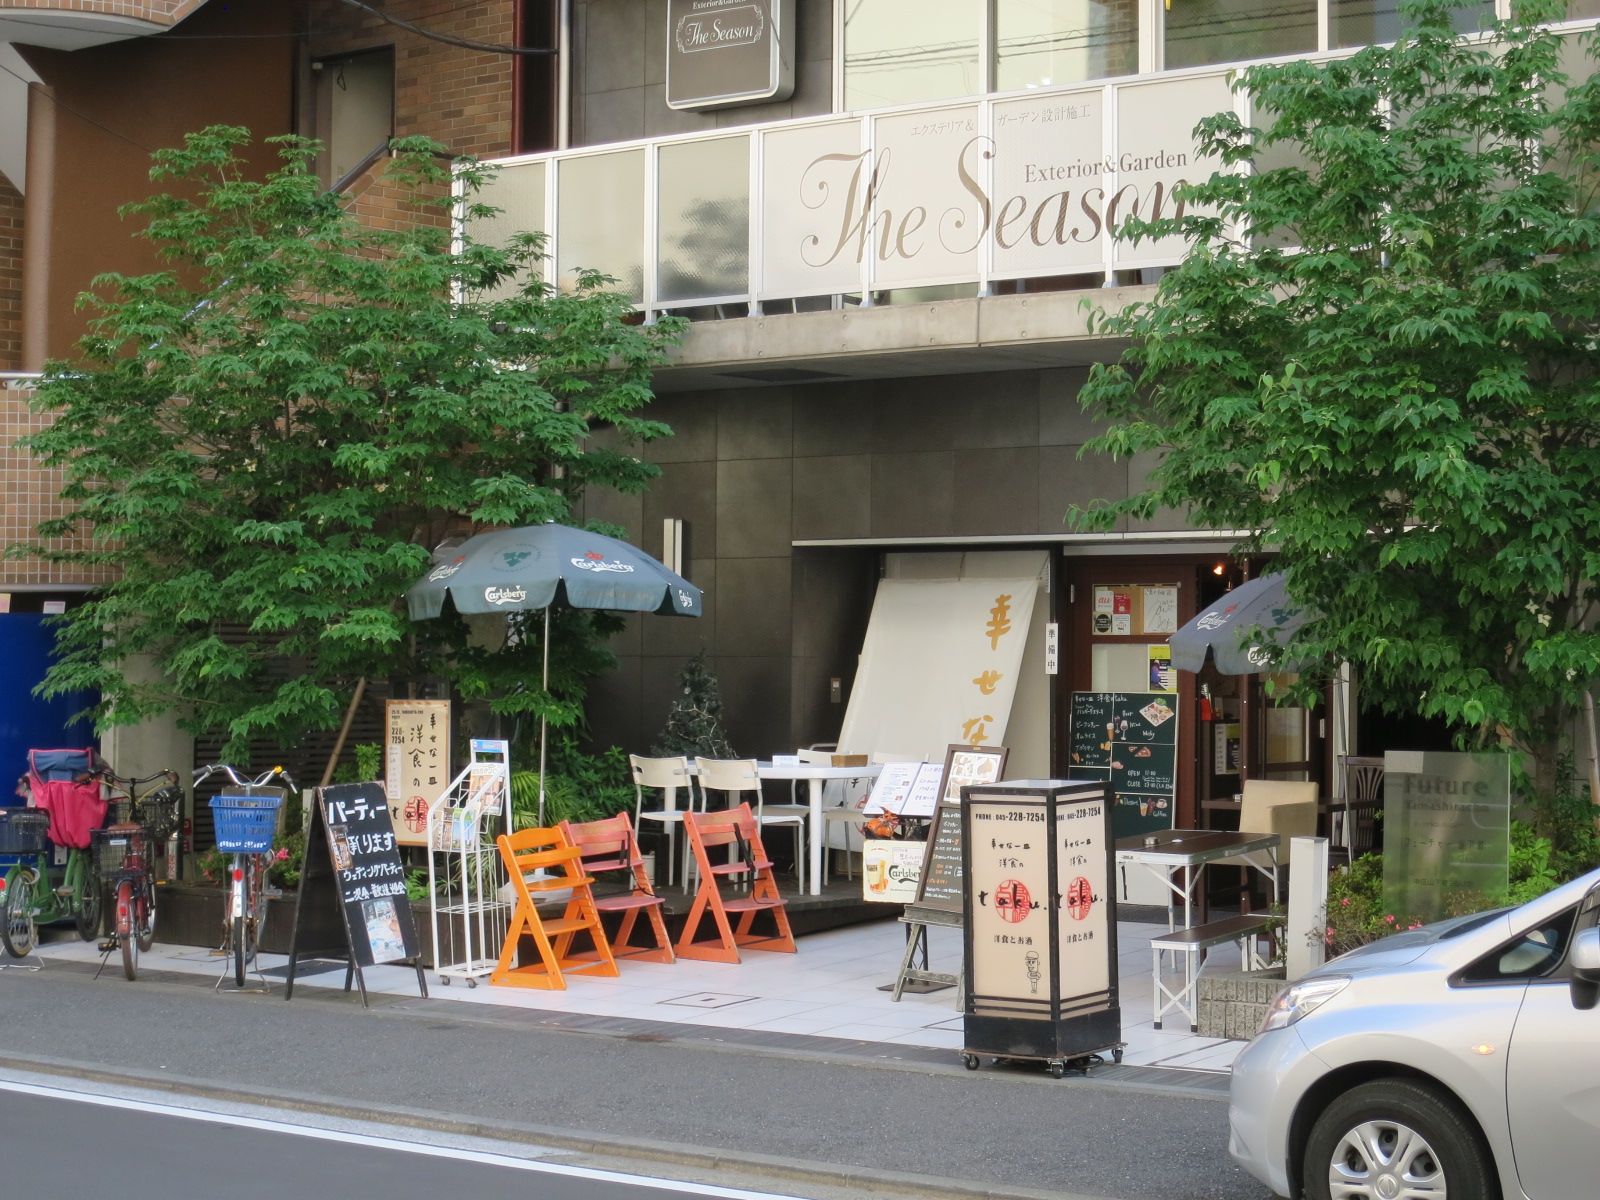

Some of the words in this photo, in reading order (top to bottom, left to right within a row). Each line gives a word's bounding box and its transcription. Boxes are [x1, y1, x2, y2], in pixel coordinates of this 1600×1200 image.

[685, 21, 709, 46] The
[709, 18, 754, 42] Season
[1025, 149, 1188, 183] Exterior&Garden
[800, 146, 927, 267] The
[938, 135, 1190, 255] Season
[570, 557, 635, 573] Carlsberg
[484, 585, 528, 606] Carlsberg
[961, 593, 1013, 747] 幸せな
[407, 722, 426, 788] 洋食の
[428, 712, 439, 787] 幸せな一皿
[328, 797, 388, 825] パーティー
[347, 832, 394, 856] 承ります
[991, 837, 1031, 850] 幸せな一皿
[998, 857, 1024, 868] 洋食の
[993, 934, 1034, 946] 洋食とお酒
